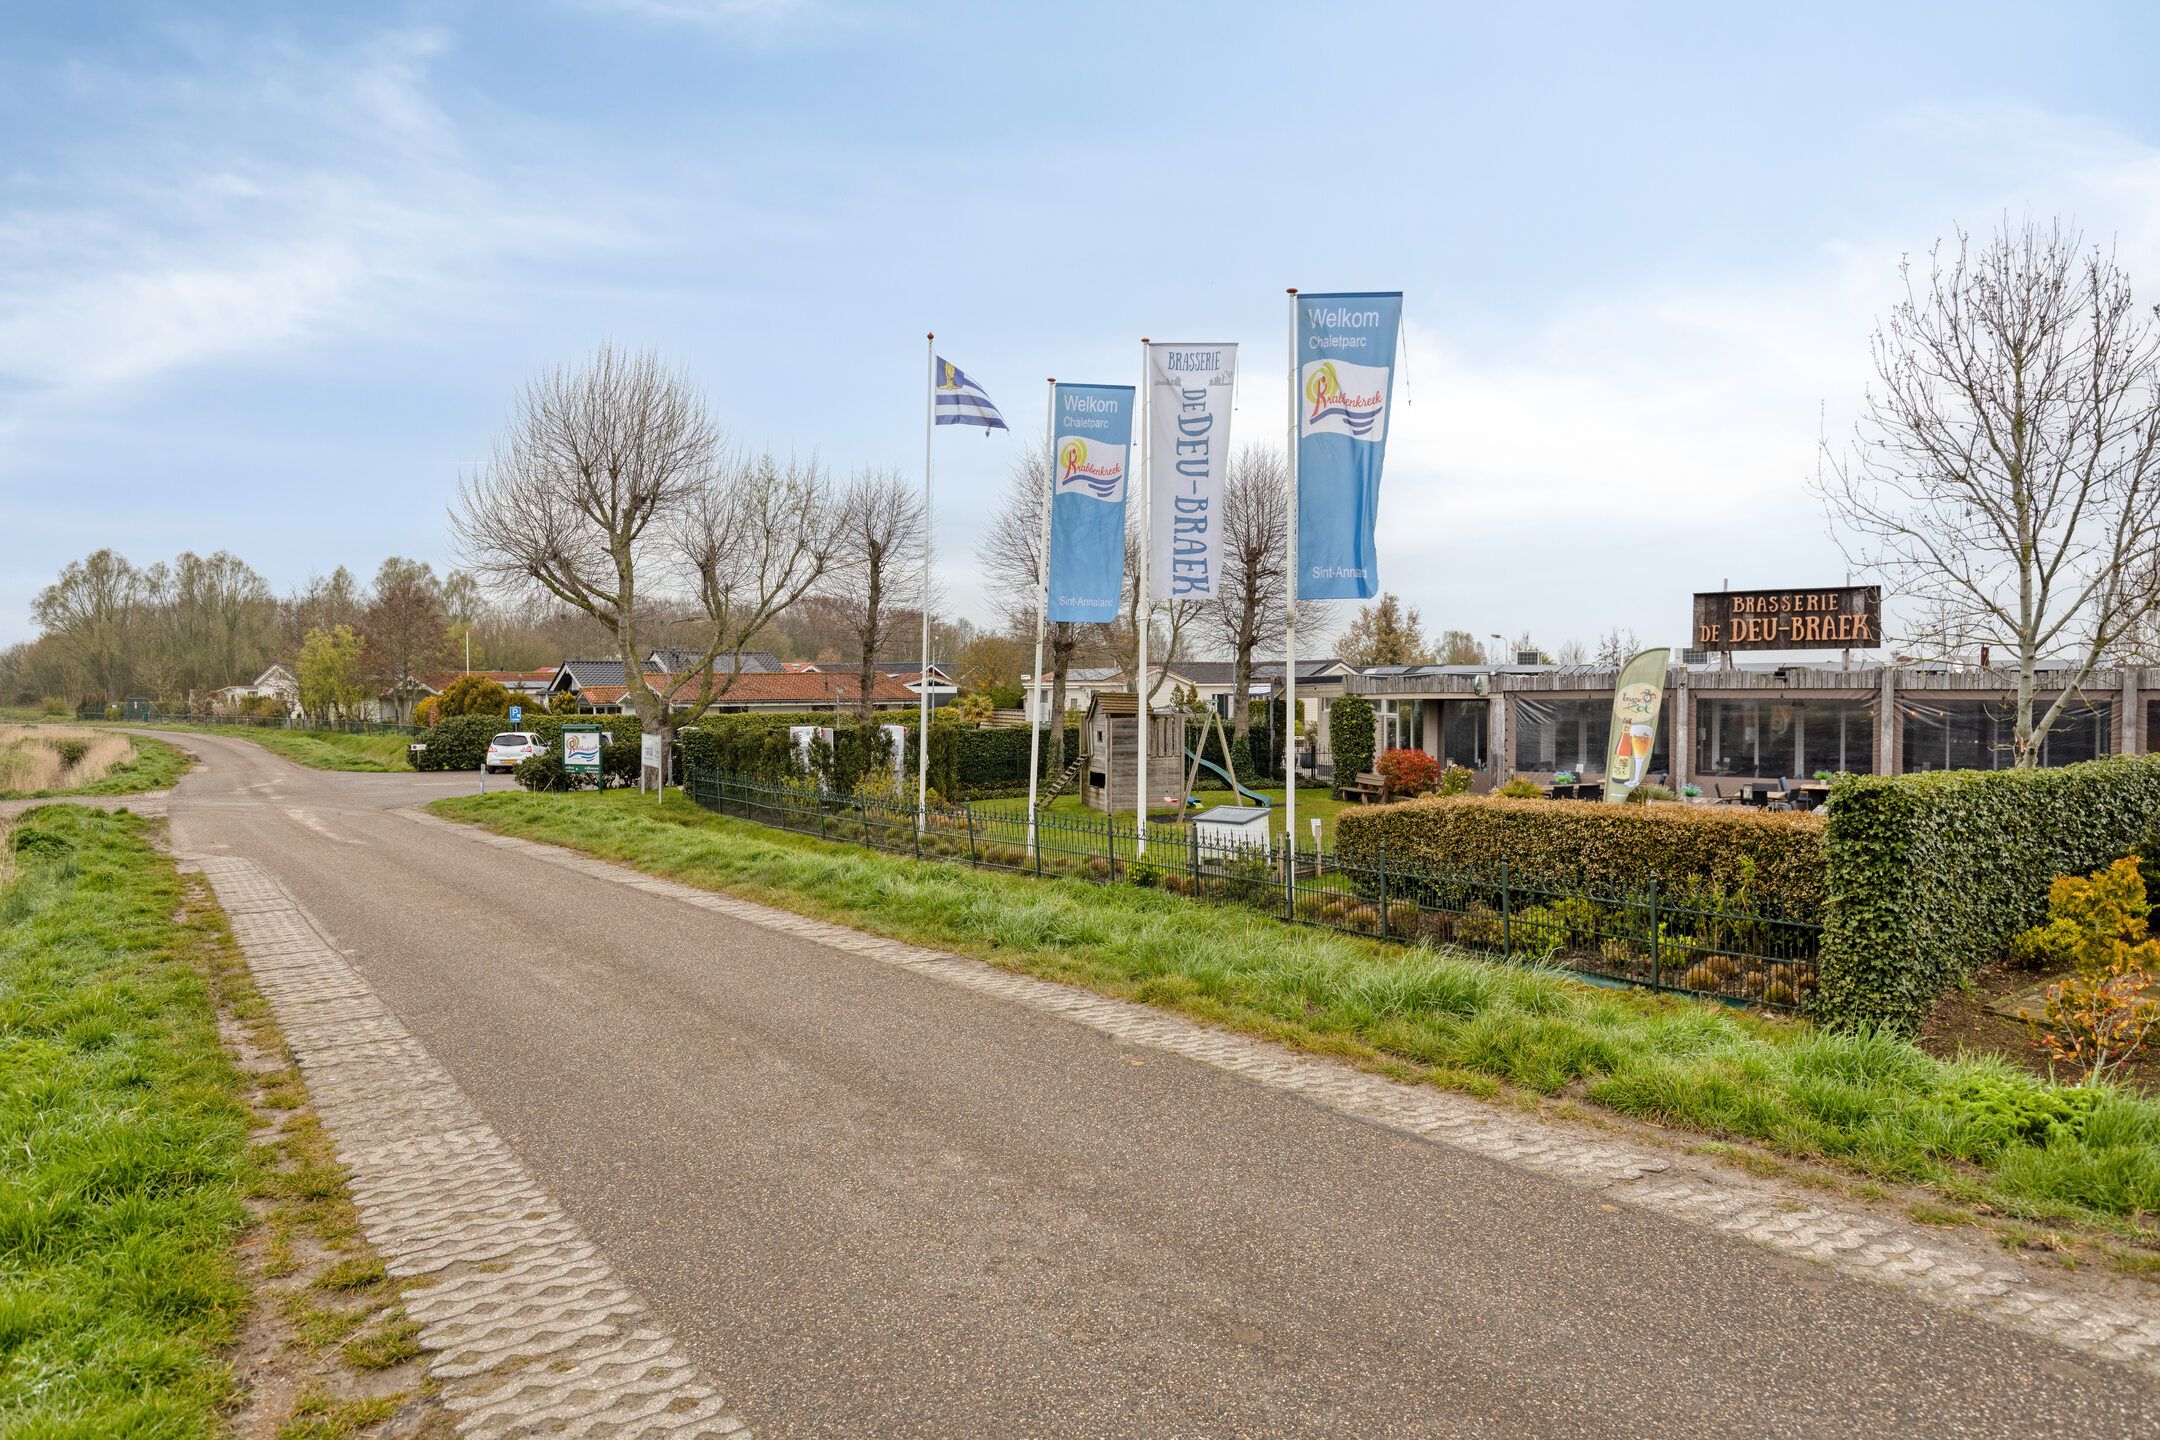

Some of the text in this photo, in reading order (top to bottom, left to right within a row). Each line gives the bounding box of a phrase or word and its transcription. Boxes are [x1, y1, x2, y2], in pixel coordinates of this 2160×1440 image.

[1308, 308, 1379, 329] Welkom
[1309, 334, 1367, 350] Chaletparc
[1168, 351, 1221, 372] BRASSERIE
[1063, 394, 1118, 414] Welkom
[1311, 376, 1382, 417] Krabbenkreek
[1063, 416, 1109, 430] Chaletparc
[1063, 448, 1122, 480] Krabbenkreek
[1172, 412, 1213, 596] DEU-BRAEK
[1059, 595, 1114, 608] Sint-Annaland
[1731, 593, 1839, 613] BRASSERIE
[1699, 614, 1871, 643] DE DEU-BRAEK
